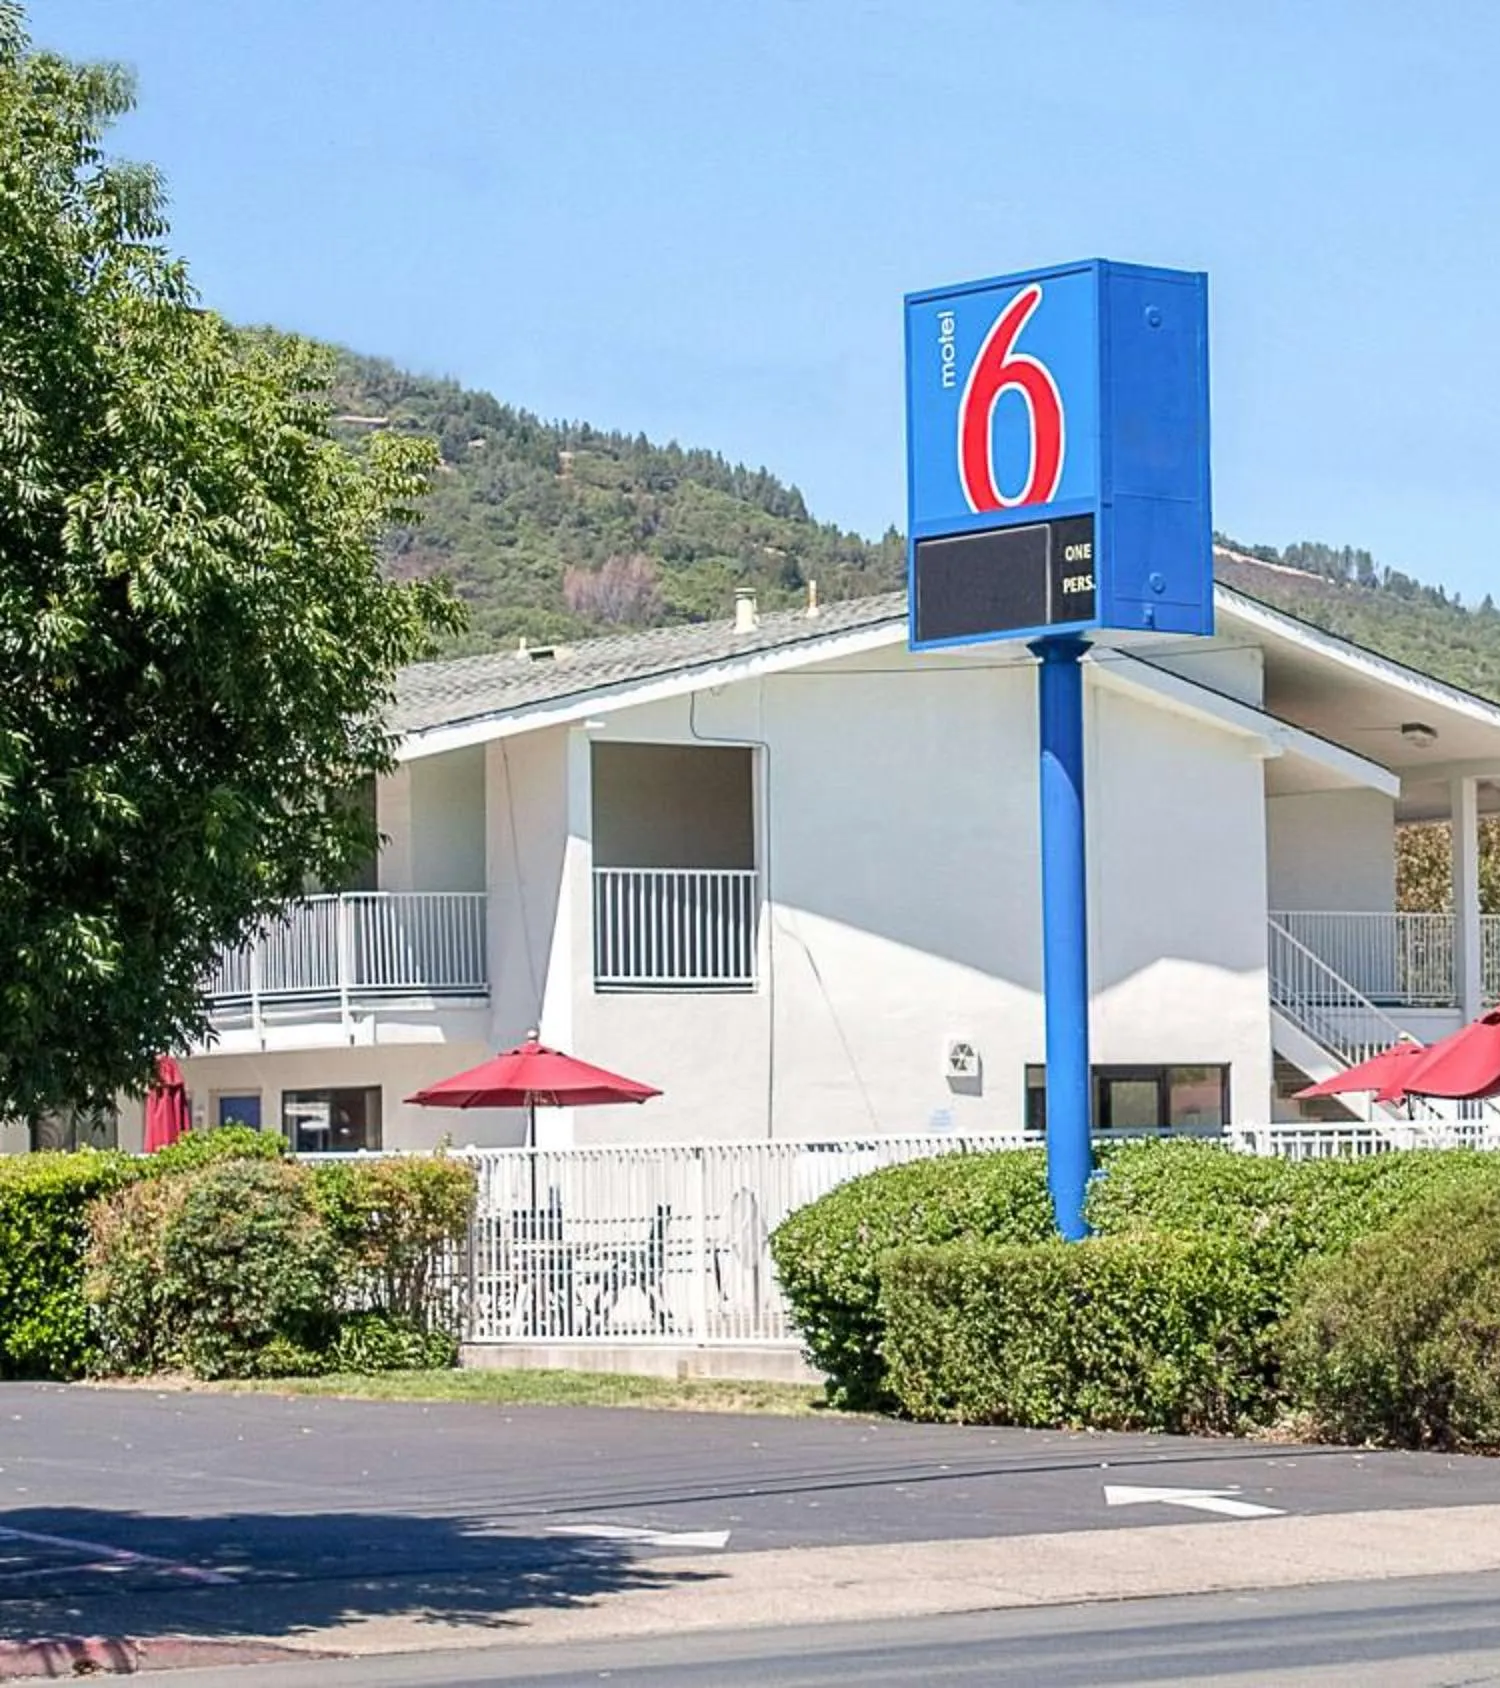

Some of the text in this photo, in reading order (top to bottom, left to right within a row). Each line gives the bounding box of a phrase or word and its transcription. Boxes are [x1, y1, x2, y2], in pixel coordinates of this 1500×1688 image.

[938, 311, 956, 388] motel
[957, 283, 1065, 514] 6
[1065, 543, 1092, 562] ONE
[1063, 574, 1096, 594] PERS.
